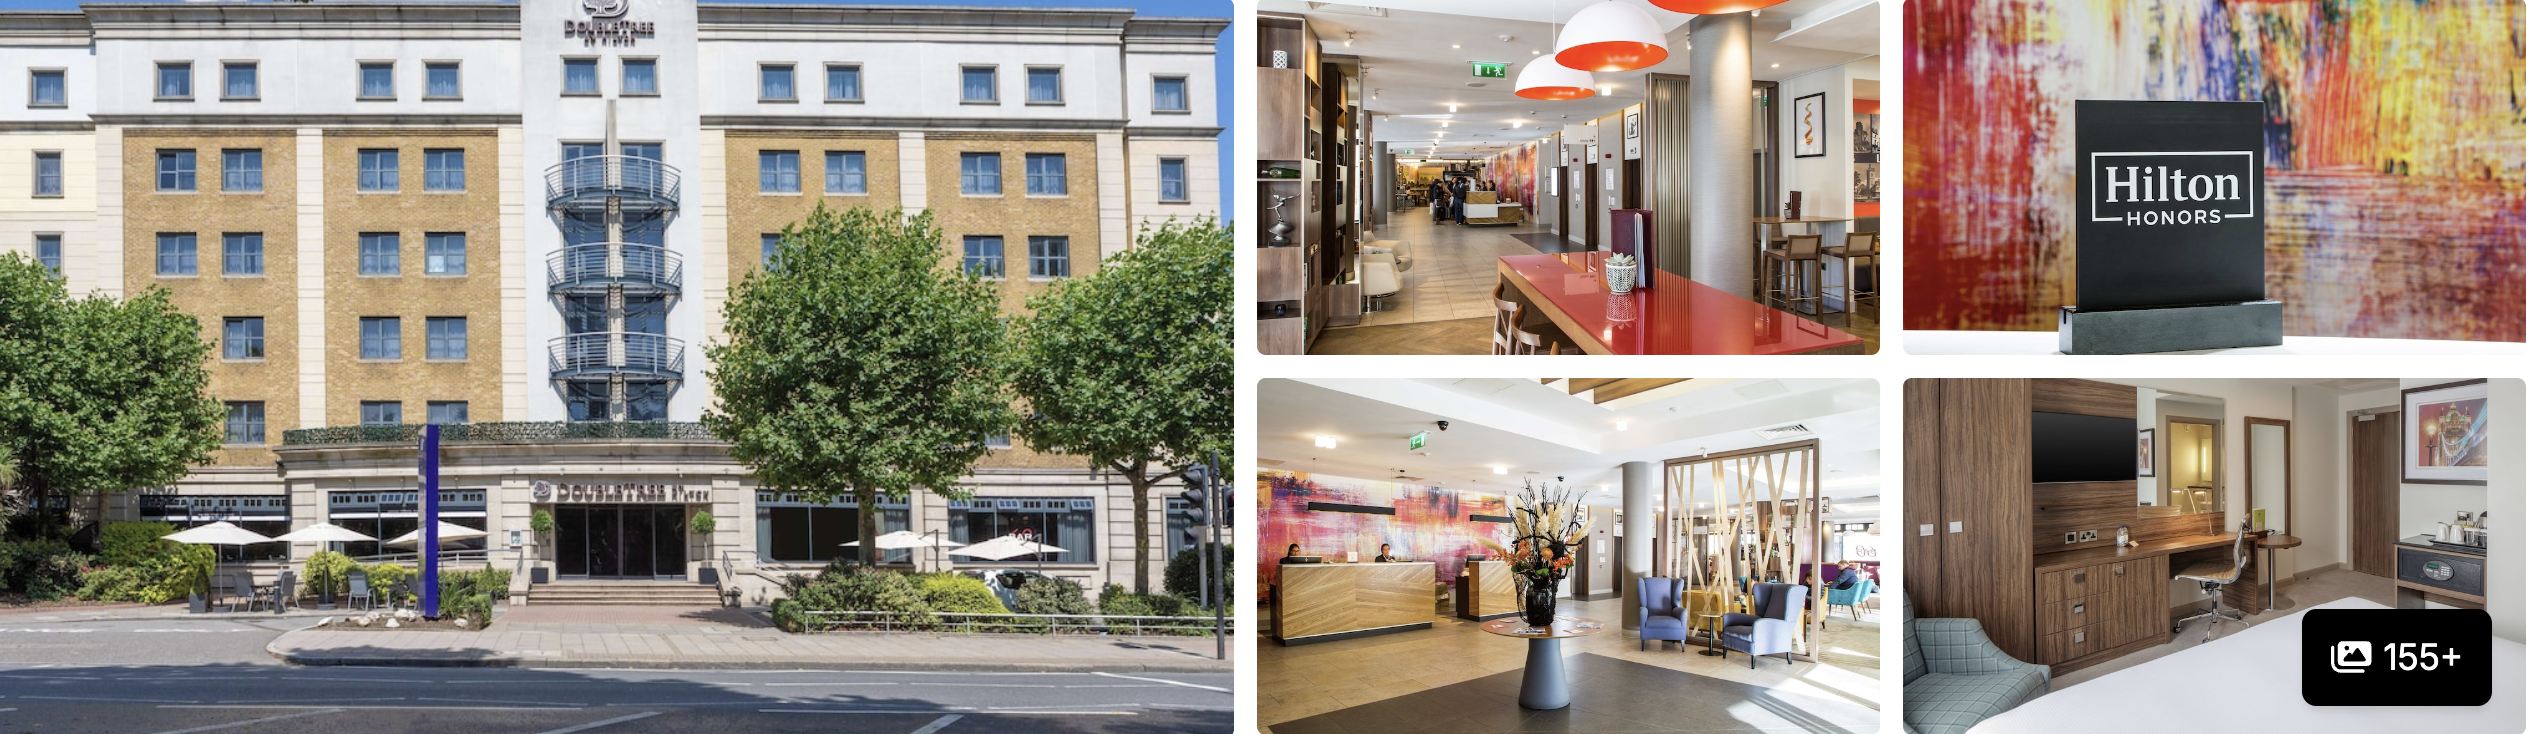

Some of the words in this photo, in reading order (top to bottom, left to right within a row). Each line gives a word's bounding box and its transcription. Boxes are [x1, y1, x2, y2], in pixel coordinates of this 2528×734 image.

[2105, 166, 2241, 203] Hilton
[2127, 209, 2222, 226] HONORS
[557, 483, 666, 500] DOUBLETREE
[1009, 533, 1032, 541] BAR
